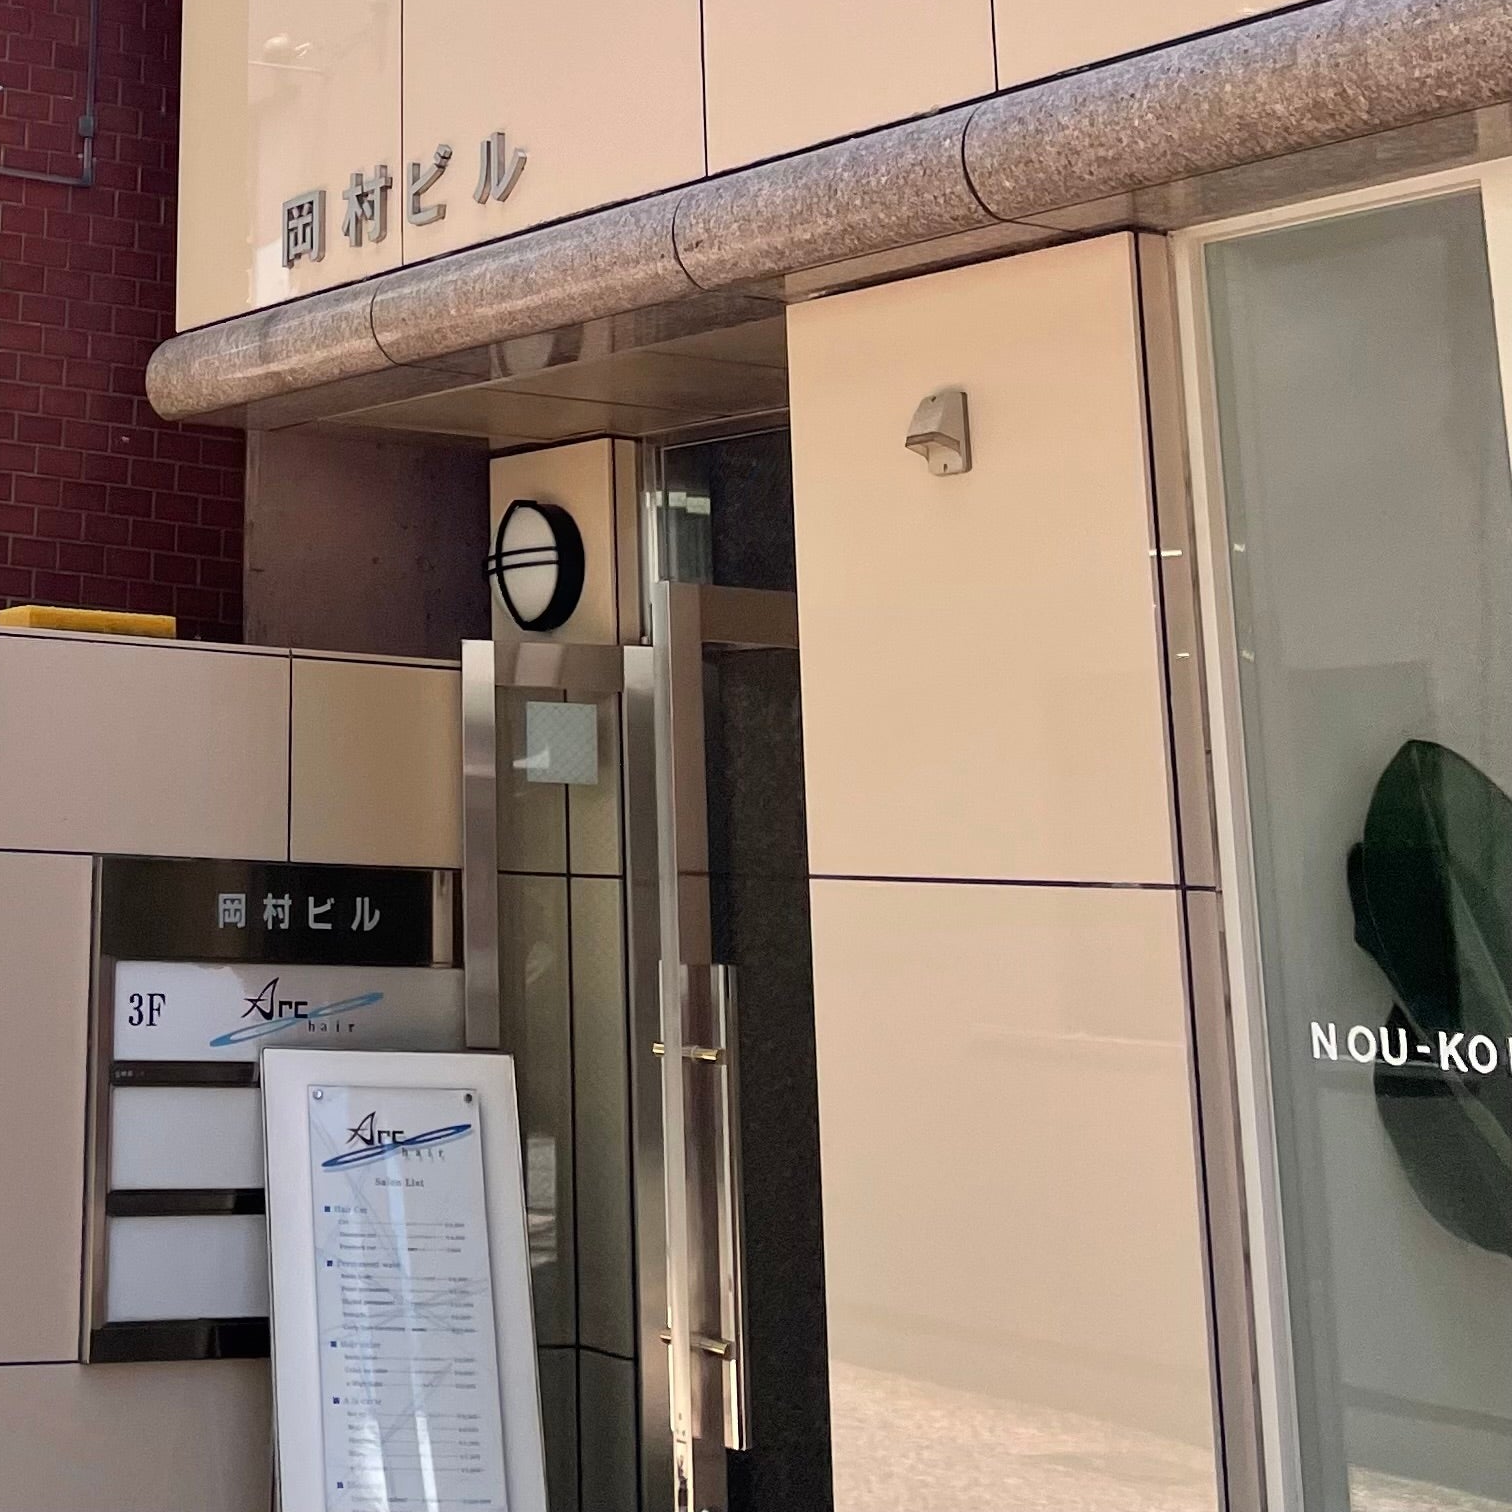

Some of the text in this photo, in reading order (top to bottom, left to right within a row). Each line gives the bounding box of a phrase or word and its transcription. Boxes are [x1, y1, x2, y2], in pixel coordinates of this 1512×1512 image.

[282, 132, 527, 268] 岡村ビル
[218, 892, 381, 931] 岡村ビル
[128, 993, 166, 1026] 3F
[241, 977, 308, 1020] Arc
[308, 1020, 356, 1033] hair
[1310, 1021, 1512, 1075] NOU-KO
[401, 1147, 445, 1159] hair
